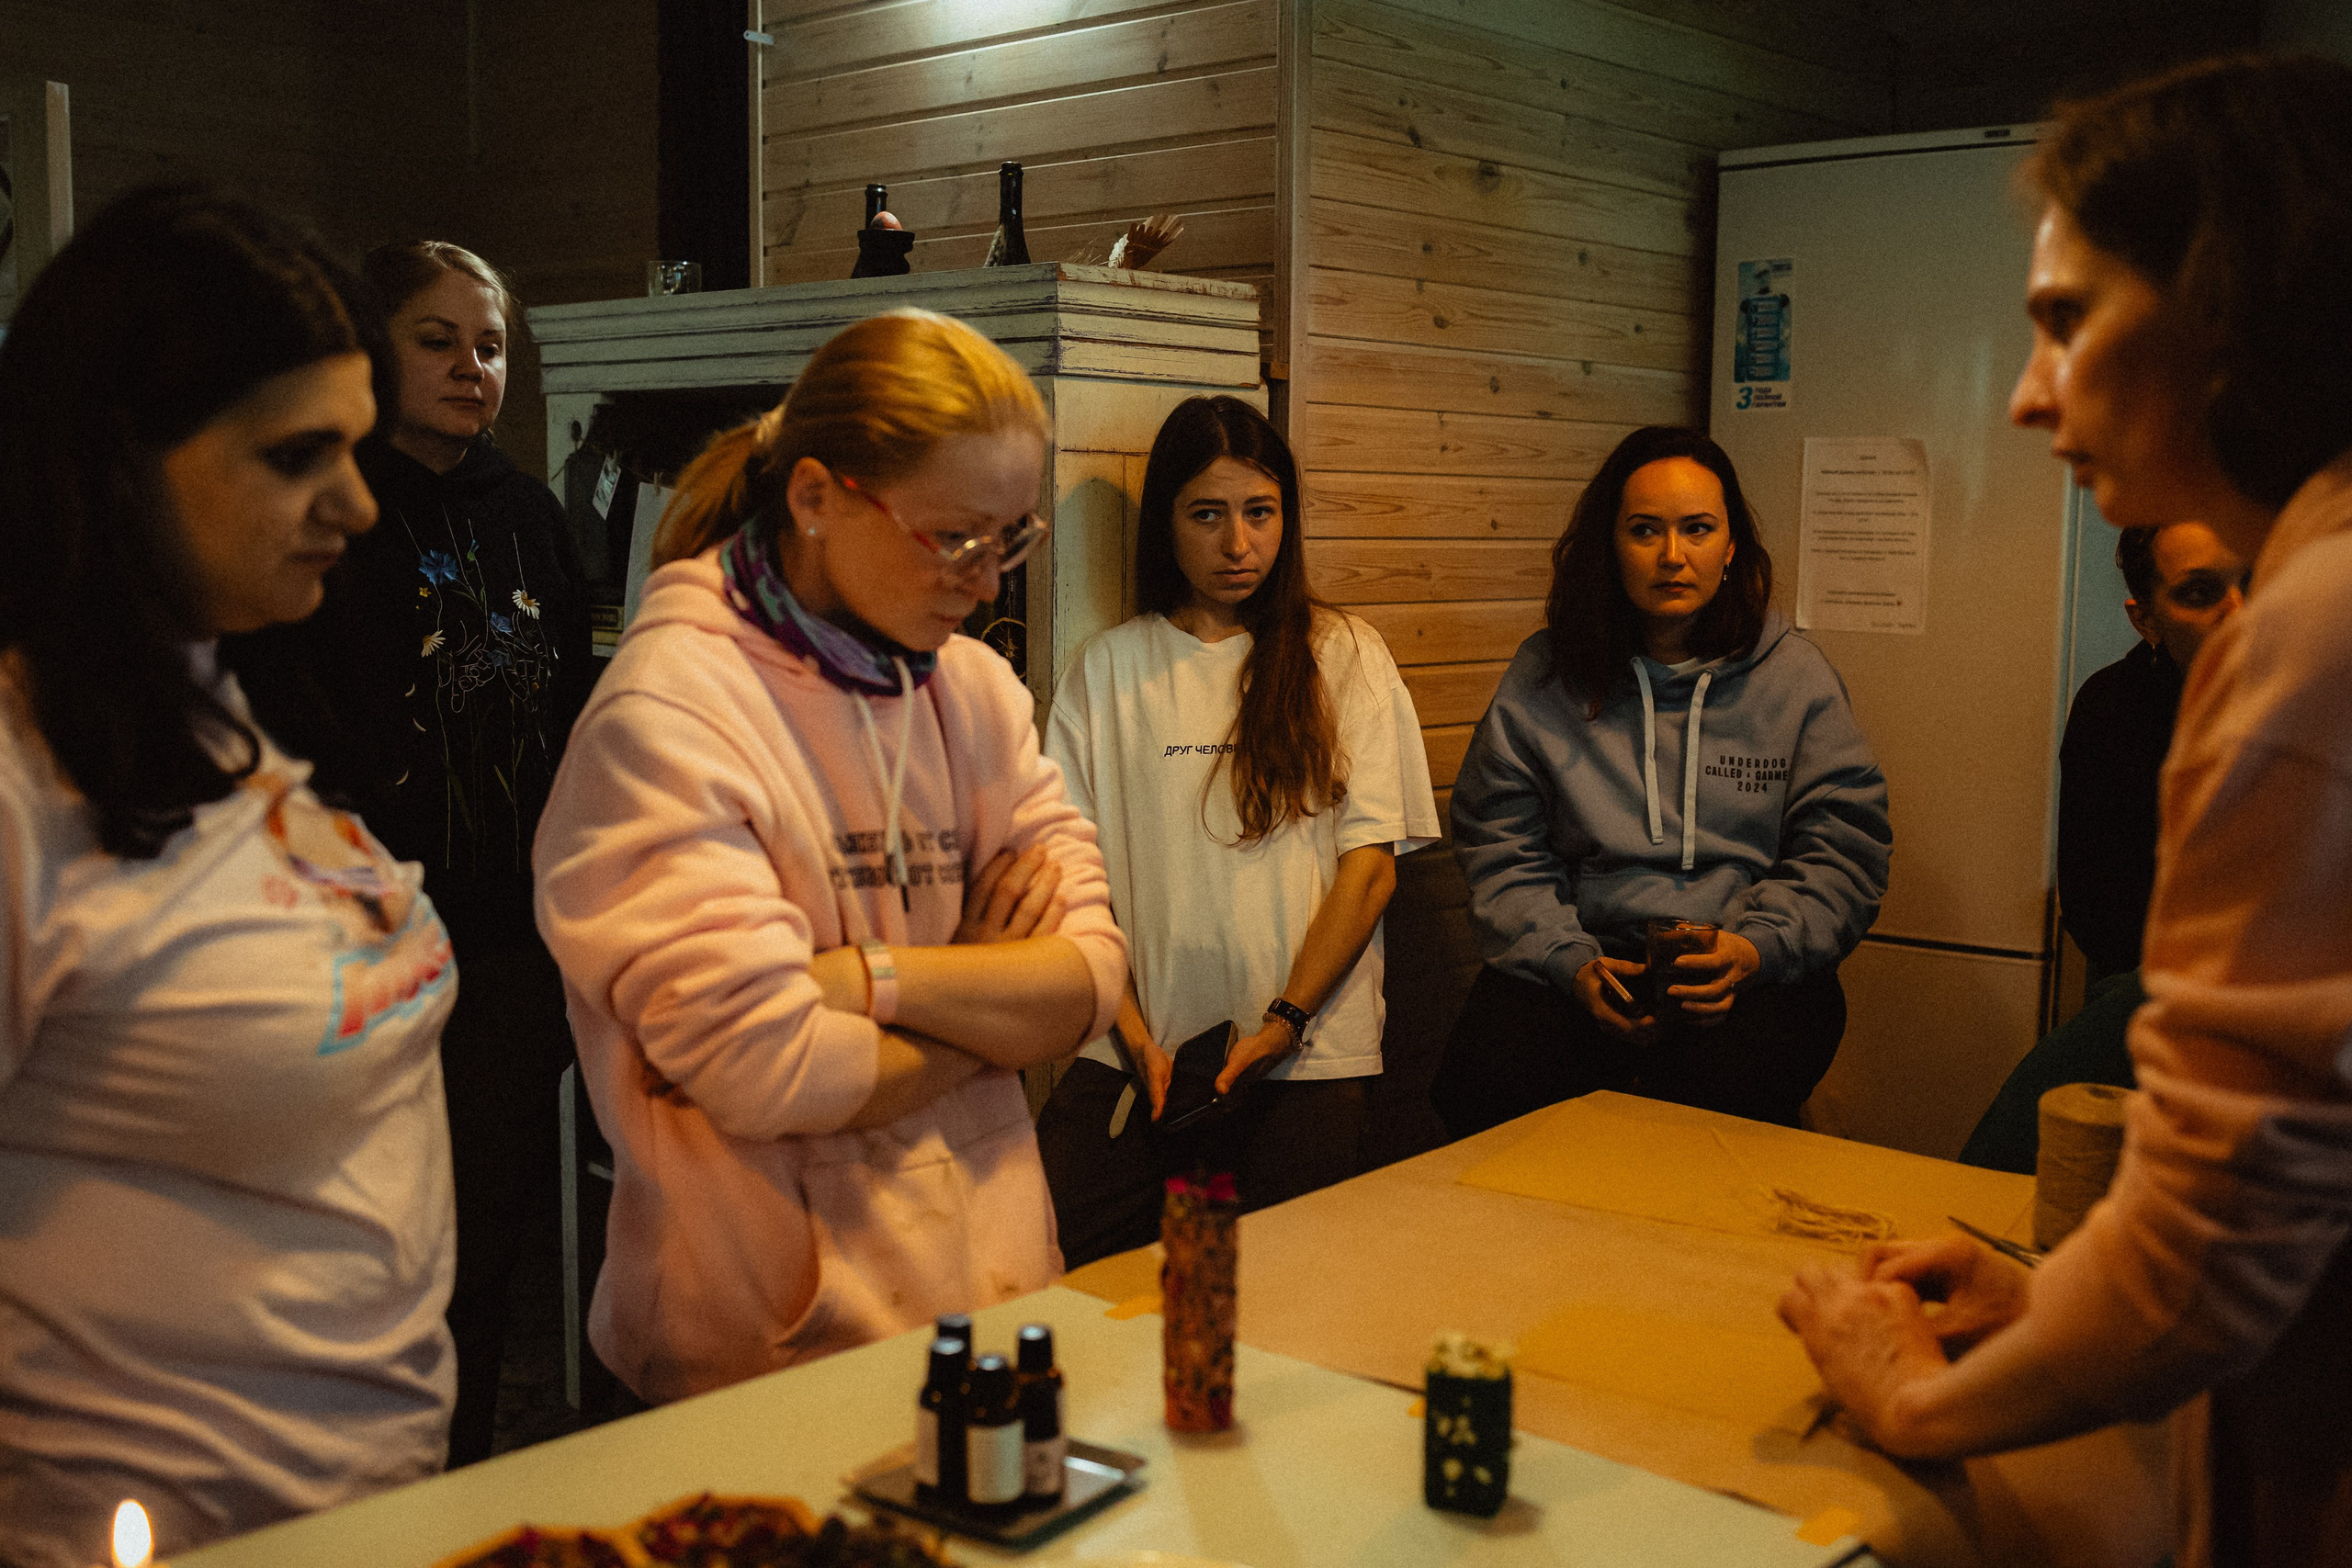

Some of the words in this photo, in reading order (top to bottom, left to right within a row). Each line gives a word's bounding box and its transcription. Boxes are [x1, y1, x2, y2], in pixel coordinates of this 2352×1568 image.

[1736, 386, 1753, 410] 3
[1164, 745, 1193, 757] ДРУГ
[1720, 755, 1787, 769] UNDERDOG
[1705, 765, 1742, 779] CALLED
[1737, 782, 1769, 794] 2024
